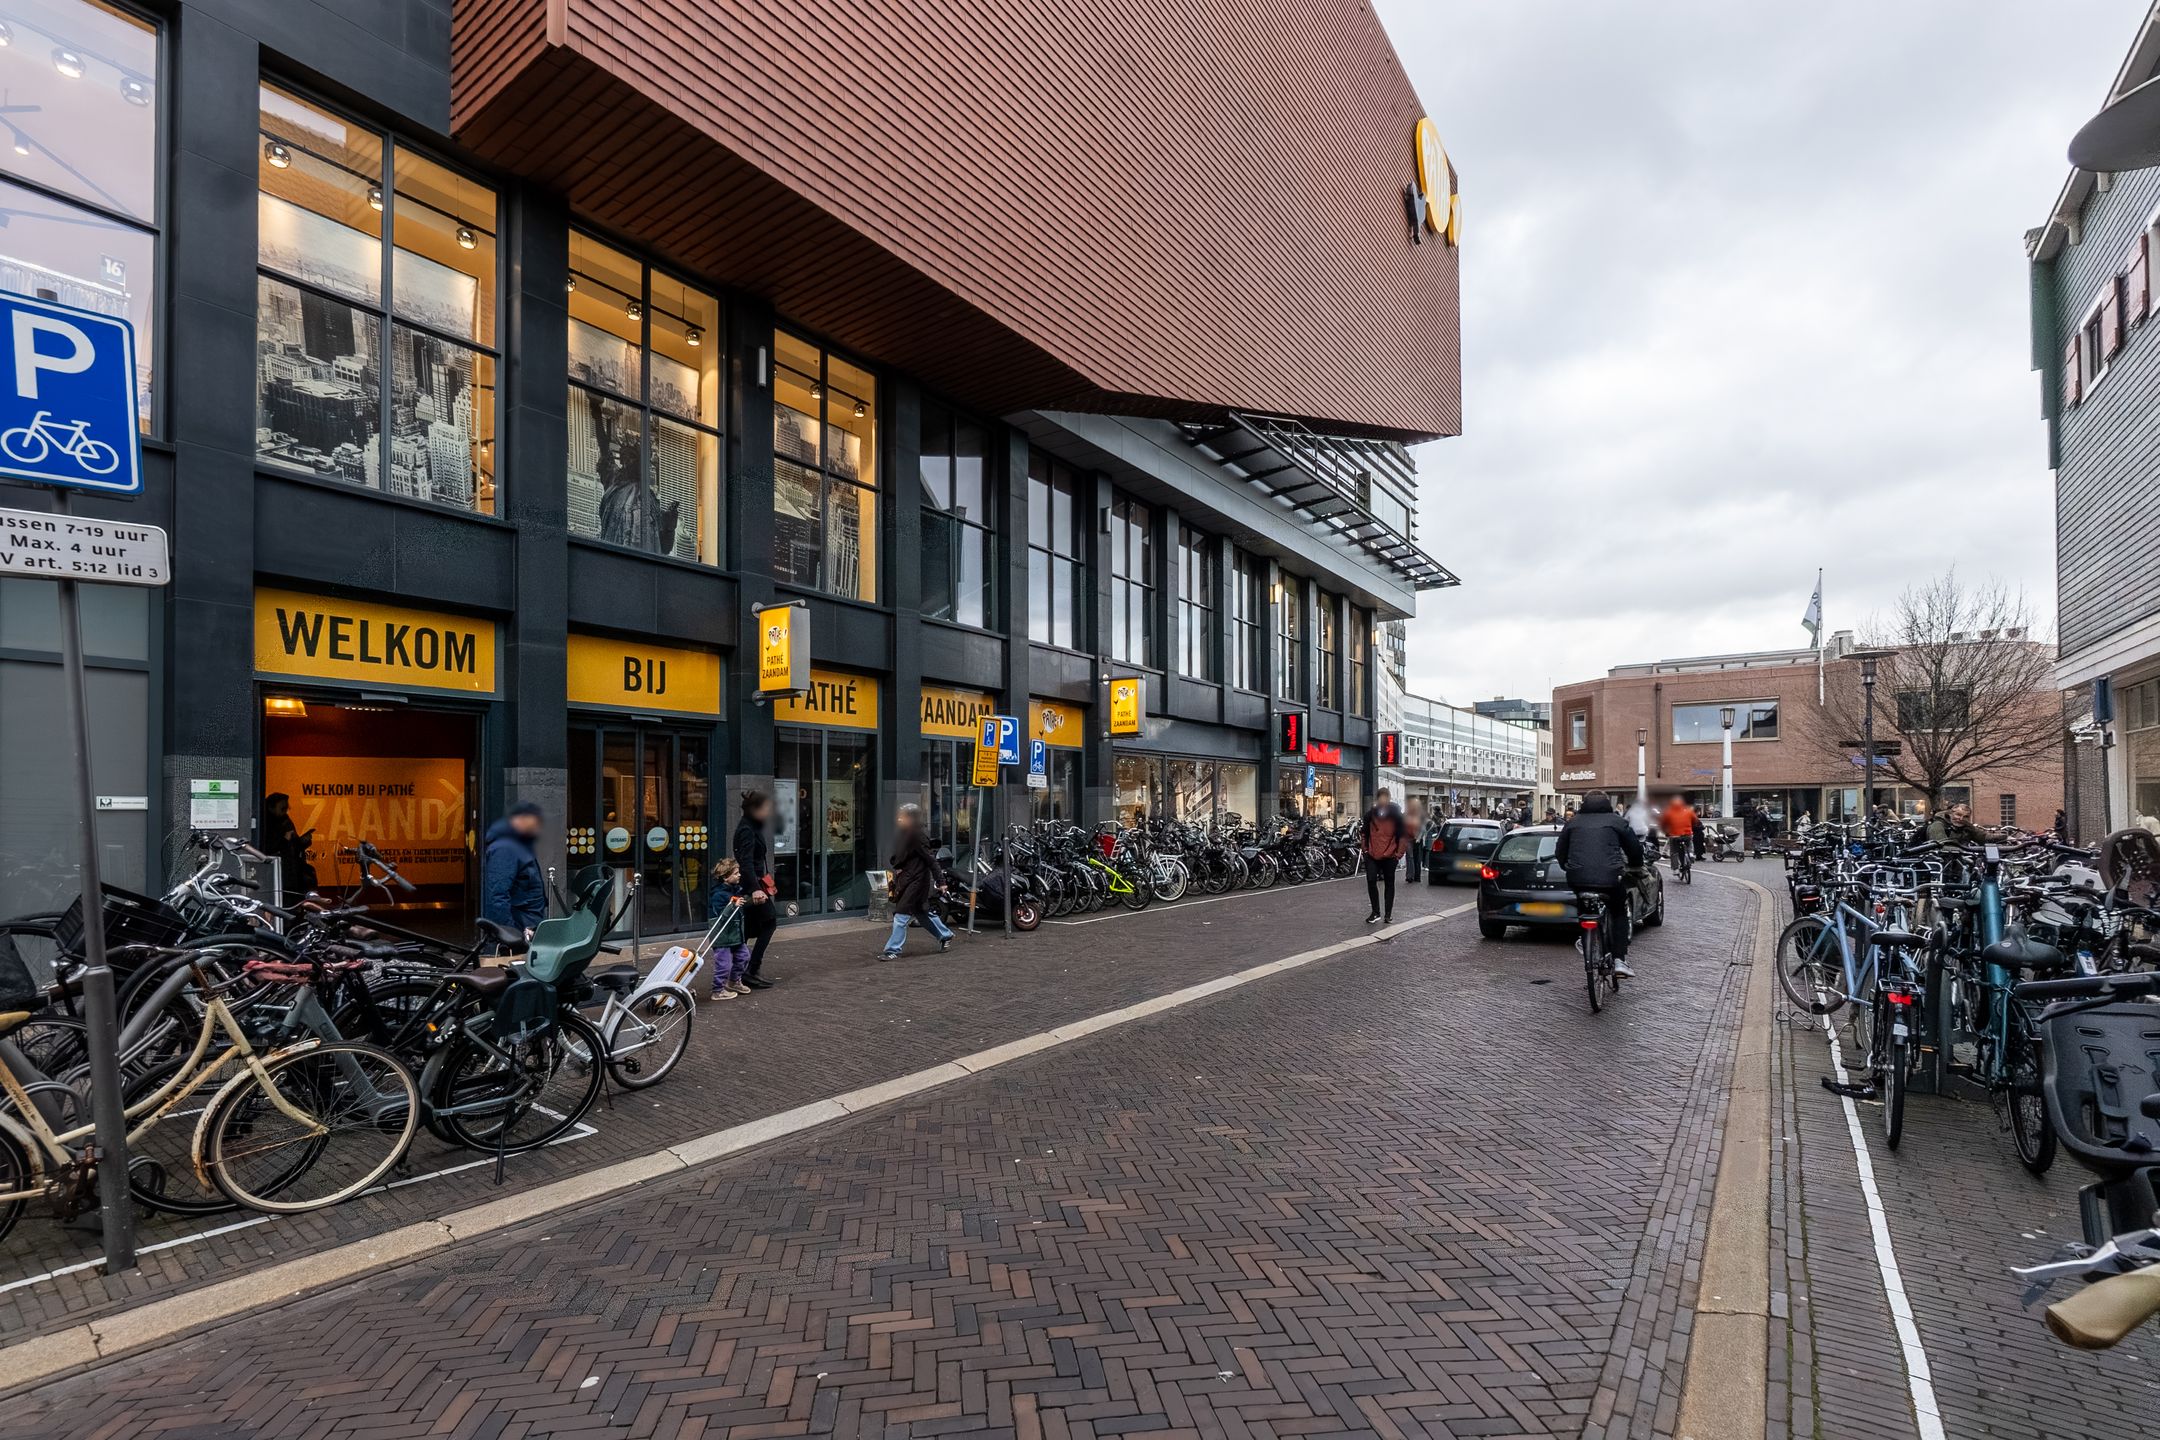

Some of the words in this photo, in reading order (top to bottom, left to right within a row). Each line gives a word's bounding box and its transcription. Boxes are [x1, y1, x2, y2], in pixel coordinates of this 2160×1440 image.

[11, 309, 96, 400] P
[66, 523, 104, 537] 7-19
[115, 529, 149, 542] uur
[11, 534, 61, 551] Max.
[71, 543, 82, 553] 4
[92, 545, 127, 557] uur
[24, 556, 62, 570] art.
[72, 561, 107, 574] 5:12
[117, 563, 142, 577] lid
[149, 568, 158, 578] 3
[275, 608, 476, 674] WELKOM
[623, 655, 666, 695] BIJ
[762, 667, 789, 679] ZAANDAM
[789, 680, 857, 715] ATHÉ
[986, 723, 994, 736] P
[1000, 720, 1014, 744] P
[1034, 741, 1042, 759] P
[302, 783, 354, 796] WELKOM
[357, 784, 375, 796] BIJ
[379, 781, 416, 797] PATHÉ
